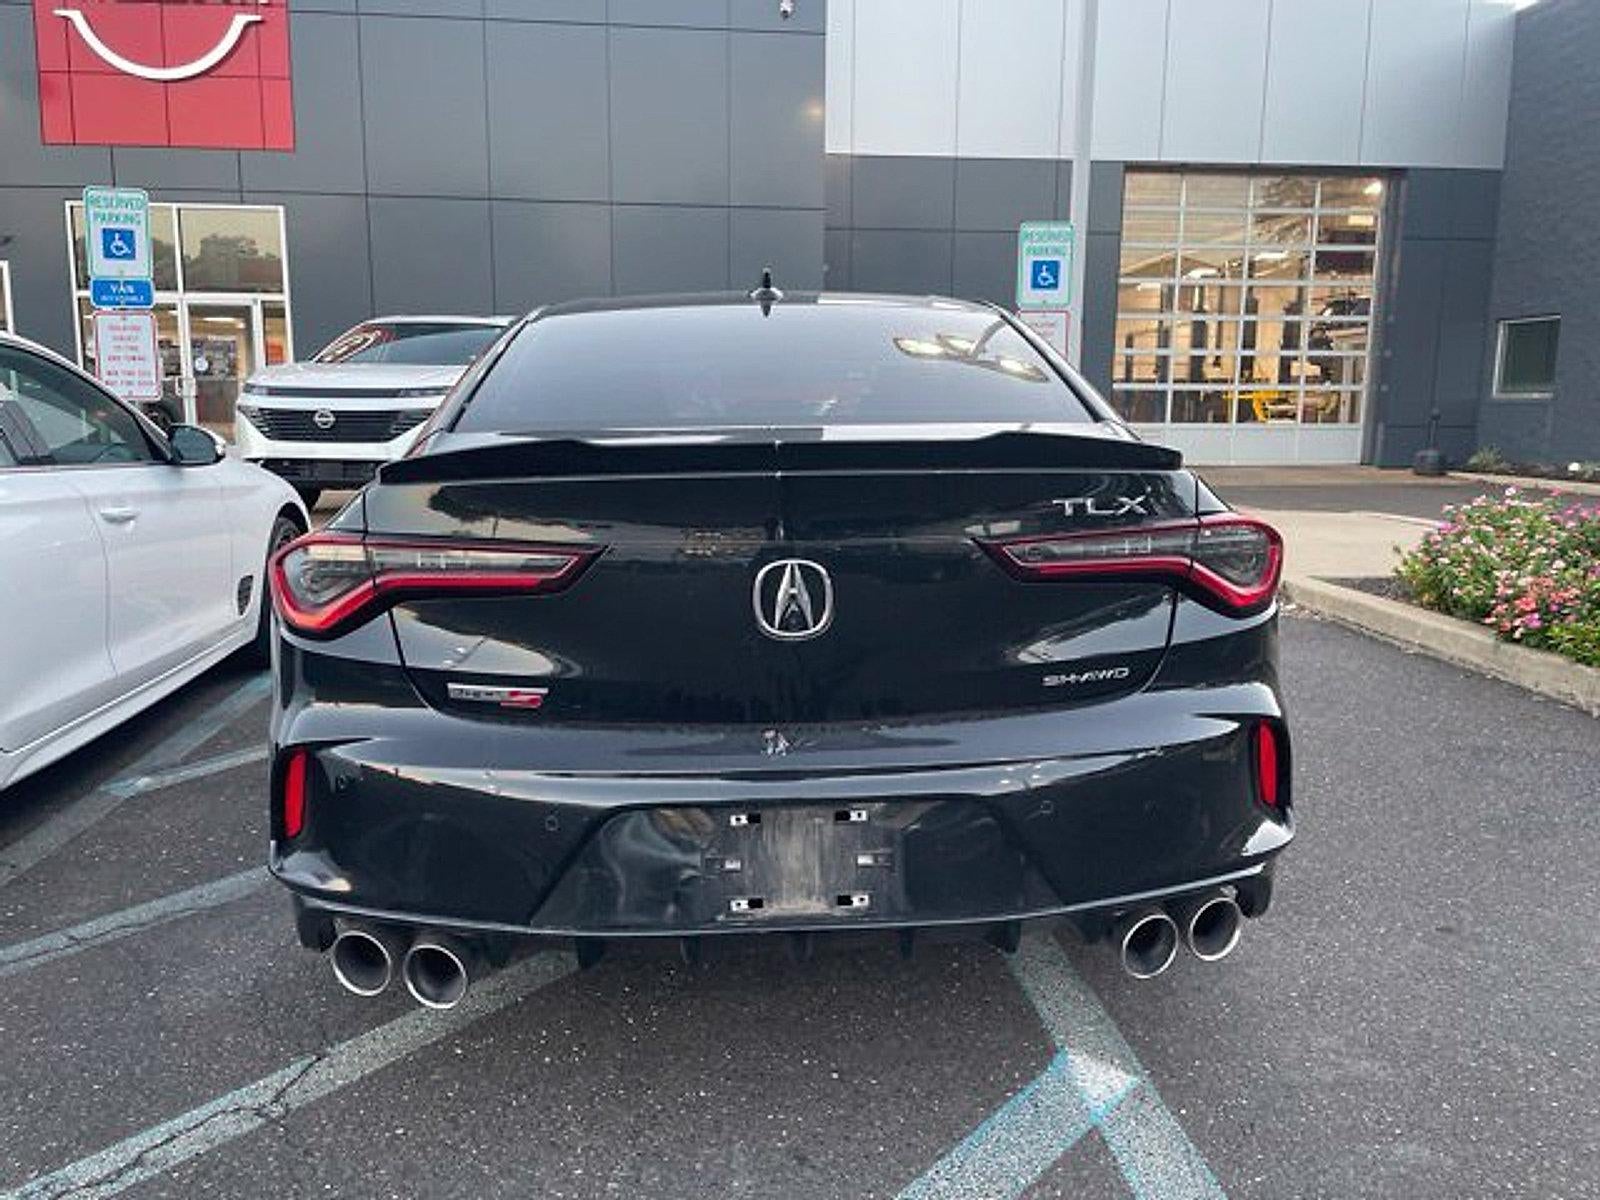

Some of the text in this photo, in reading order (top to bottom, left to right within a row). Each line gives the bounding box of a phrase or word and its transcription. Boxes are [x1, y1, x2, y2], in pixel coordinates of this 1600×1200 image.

[87, 194, 147, 210] RESERVED
[93, 211, 142, 225] PARKING
[1053, 495, 1148, 516] TLX
